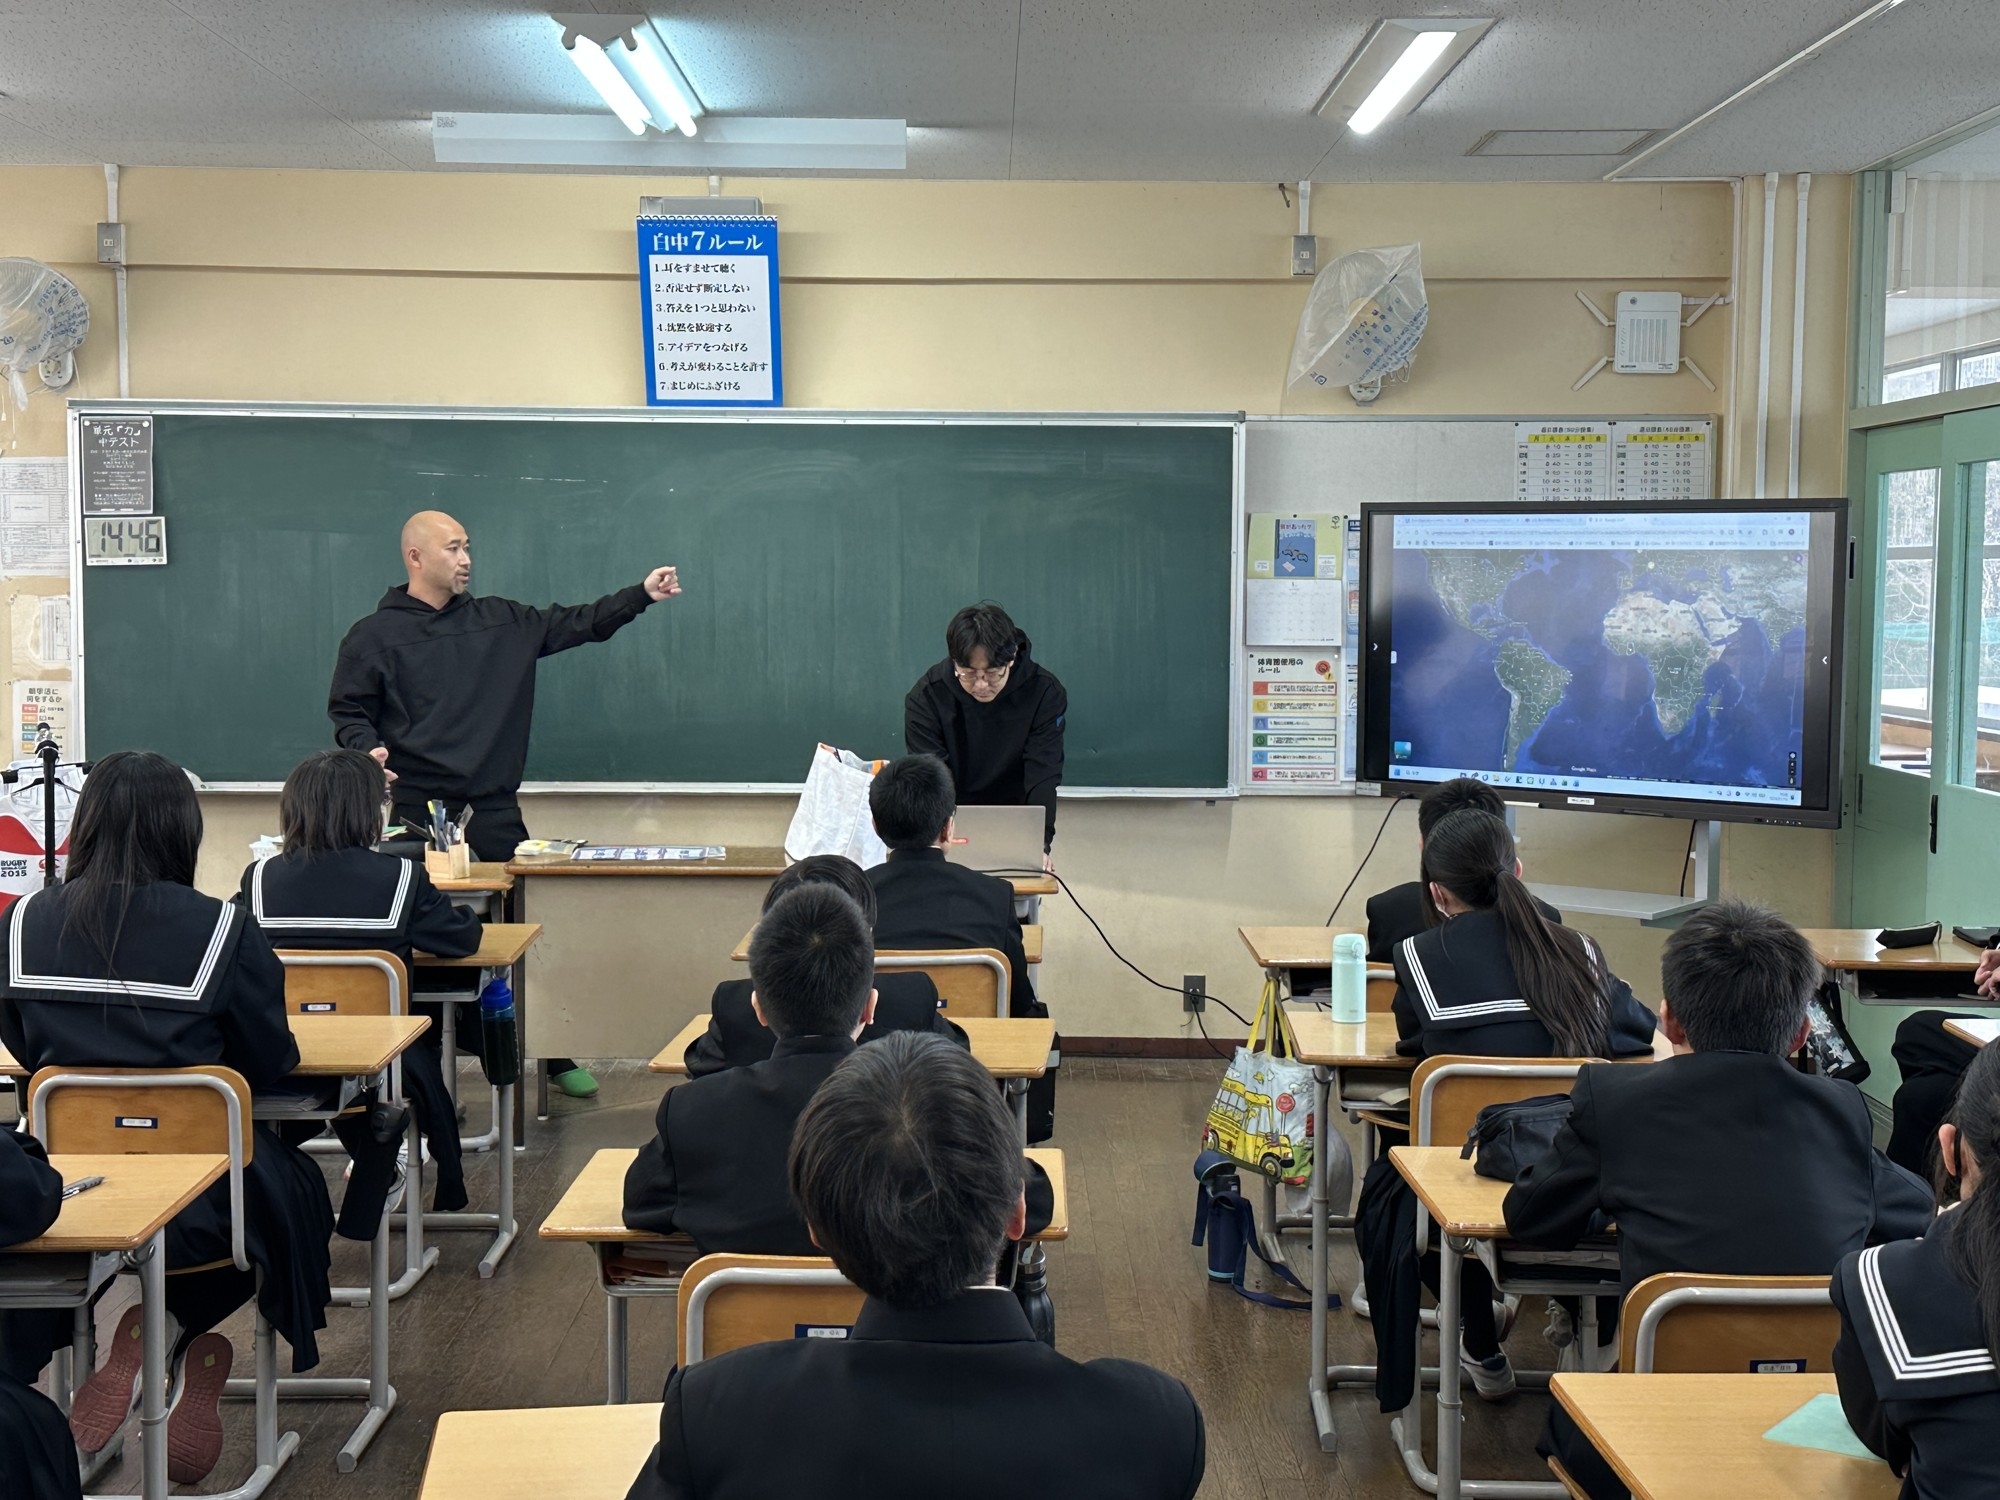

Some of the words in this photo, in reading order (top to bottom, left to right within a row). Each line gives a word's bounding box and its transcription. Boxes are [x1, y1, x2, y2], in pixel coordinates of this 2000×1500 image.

[653, 231, 763, 251] 白中7ルール
[658, 342, 748, 352] 5.アイデアをつなげる
[1257, 666, 1281, 674] ルール
[1, 869, 28, 878] 2015
